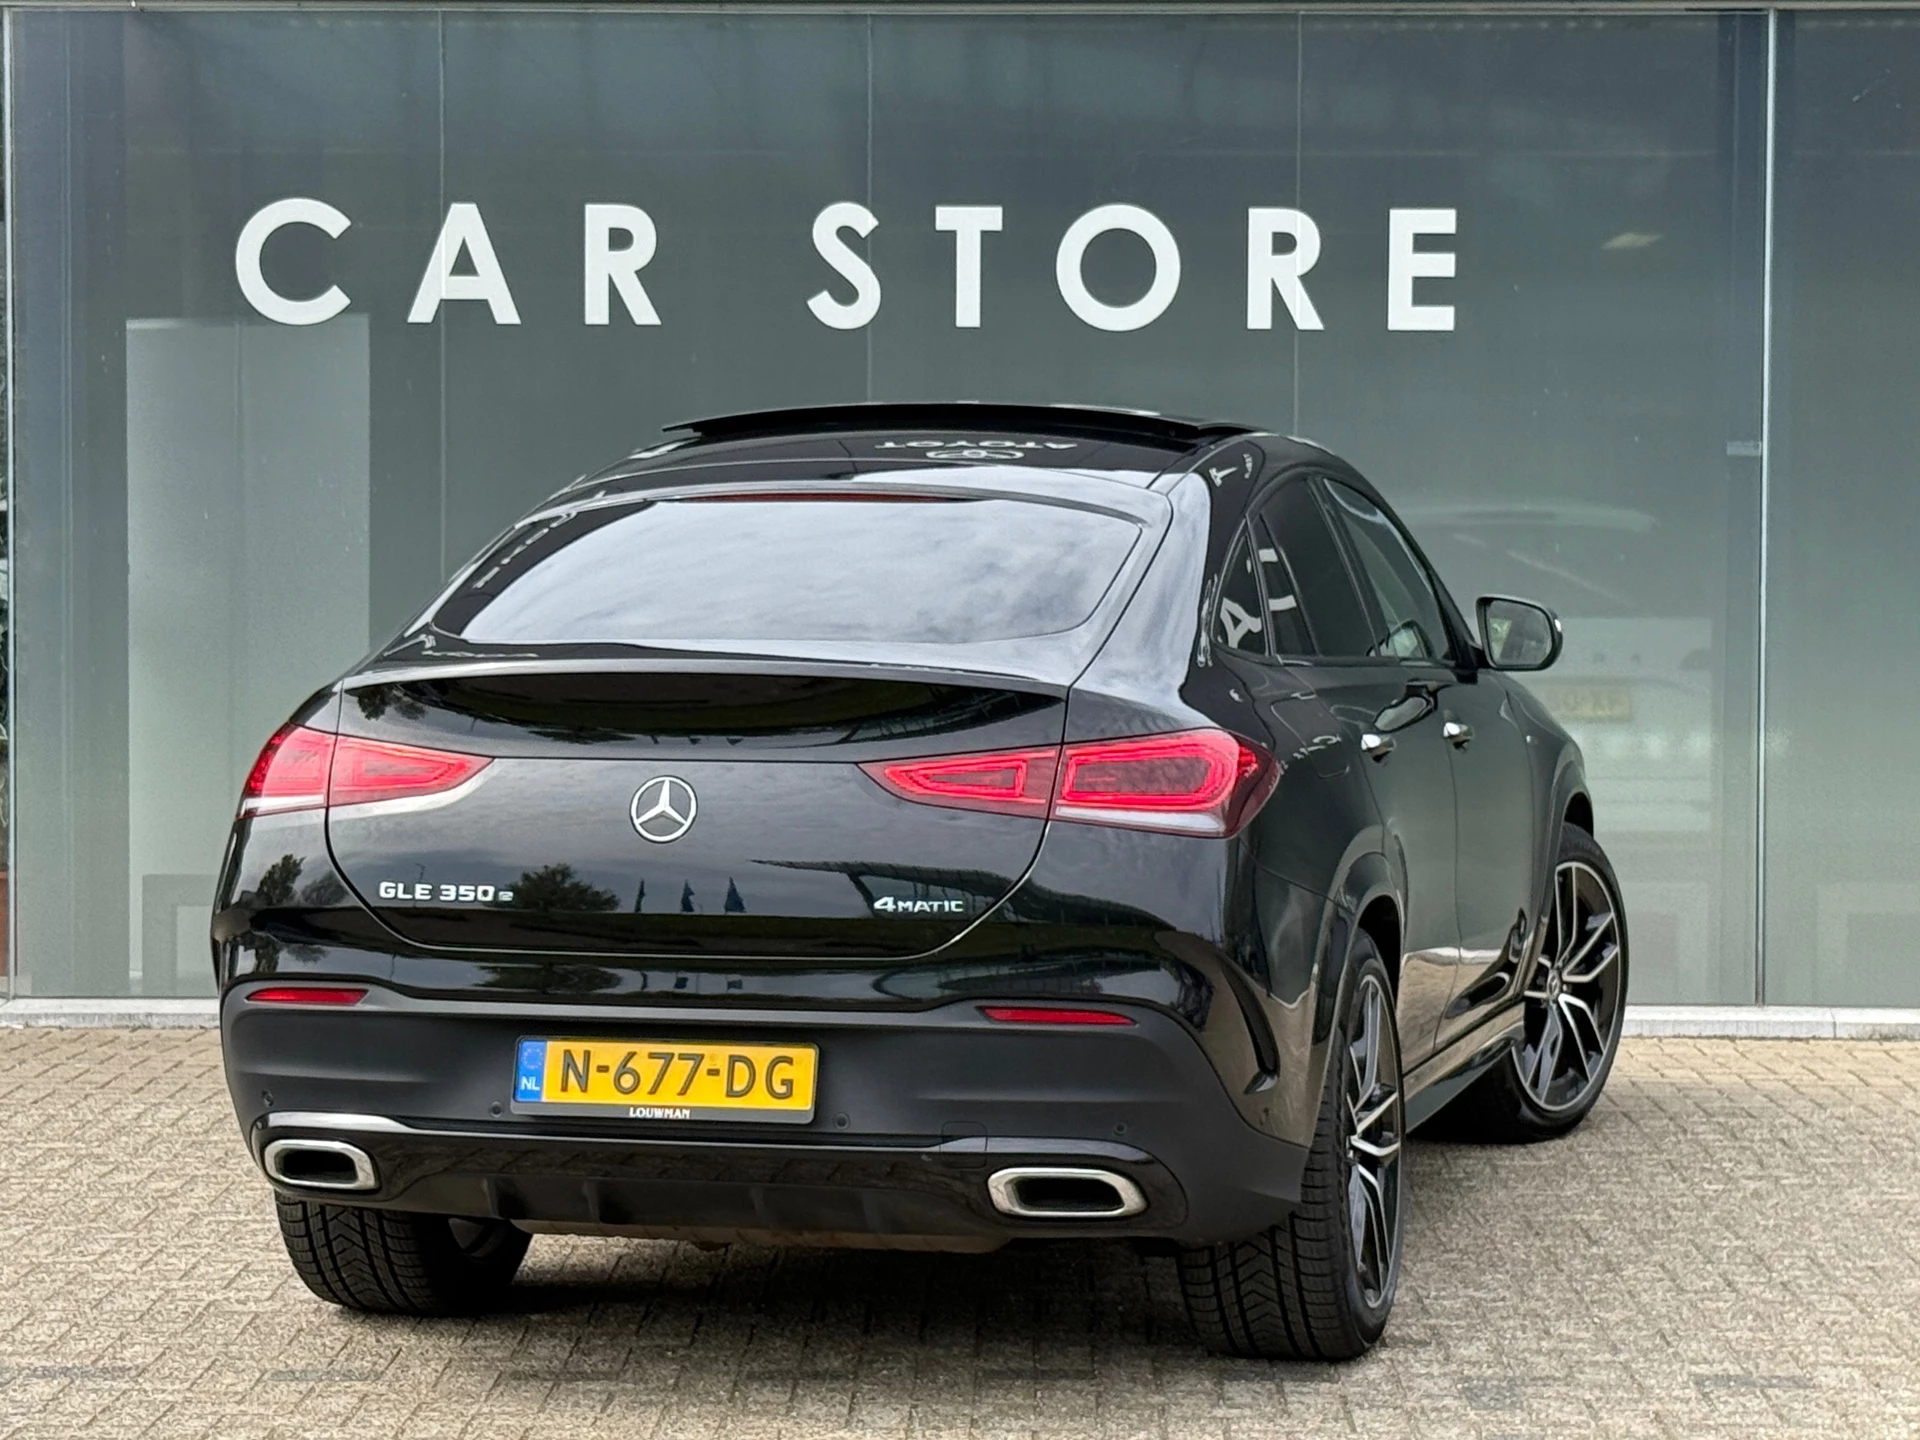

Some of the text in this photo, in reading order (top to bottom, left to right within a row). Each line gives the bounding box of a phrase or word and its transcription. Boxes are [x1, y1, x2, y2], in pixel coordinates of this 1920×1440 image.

[235, 198, 1457, 331] CAR STORE
[379, 881, 433, 900] GLE
[873, 896, 964, 913] 4MATIC
[520, 1076, 540, 1091] NL
[560, 1049, 794, 1100] N-677-DG
[628, 1107, 691, 1119] LOUWMAN
